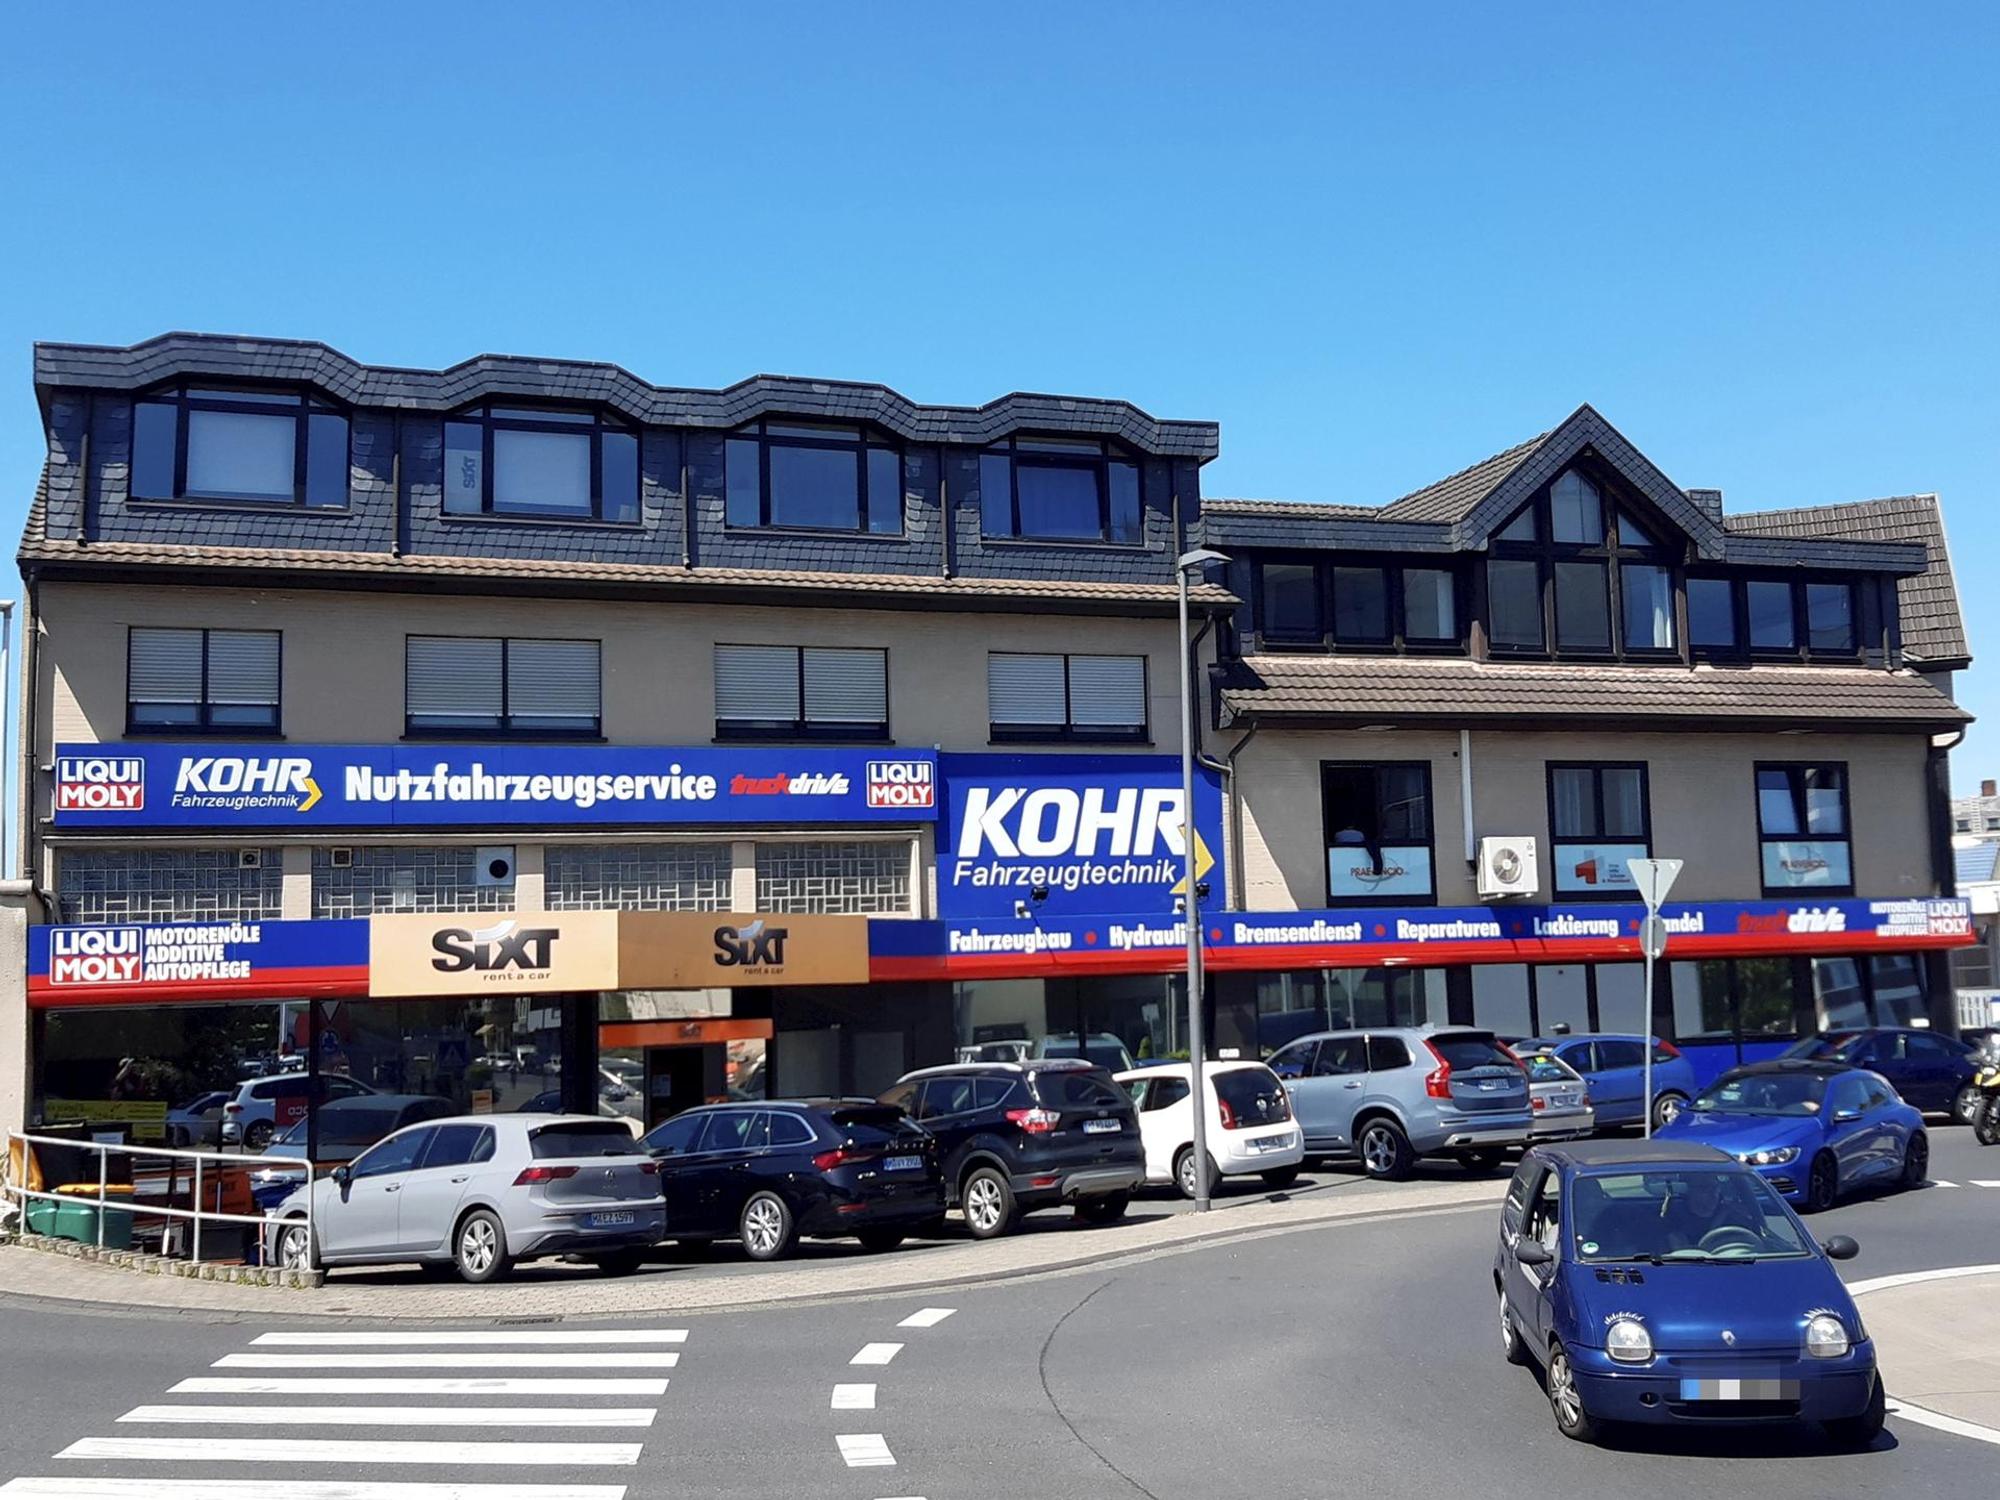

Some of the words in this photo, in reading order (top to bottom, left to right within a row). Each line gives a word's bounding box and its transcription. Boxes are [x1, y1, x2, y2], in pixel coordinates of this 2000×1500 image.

[61, 760, 139, 784] LIQUI
[175, 758, 312, 793] KOHR
[870, 763, 930, 785] LIQUI
[60, 784, 140, 808] MOLY
[345, 763, 717, 808] Nutzfahrzeugservice
[871, 784, 931, 805] MOLY
[171, 793, 300, 811] Fahrzeugtechnik
[958, 788, 1188, 858] KOHR
[953, 859, 1177, 889] Fahrzeugtechnik
[1930, 901, 1967, 917] LIQUI
[144, 921, 261, 946] MOTORENÖLE
[949, 926, 1072, 954] Fahrzeugbau
[1109, 922, 1203, 951] Hydrauli
[1234, 919, 1362, 944] Bremsendienst
[1396, 919, 1501, 943] Reparaturen
[1534, 914, 1619, 939] Lackierung
[1662, 911, 1704, 933] andel
[1930, 918, 1968, 934] MOLY
[55, 930, 138, 956] LIQUI
[144, 944, 225, 963] ADDITIVE
[431, 919, 560, 973] SIXT
[714, 919, 788, 967] SIXT
[54, 956, 140, 982] MOLY
[144, 960, 251, 982] AUTOPFLEGE
[483, 972, 513, 981] rent
[517, 972, 525, 980] a
[528, 971, 552, 980] car
